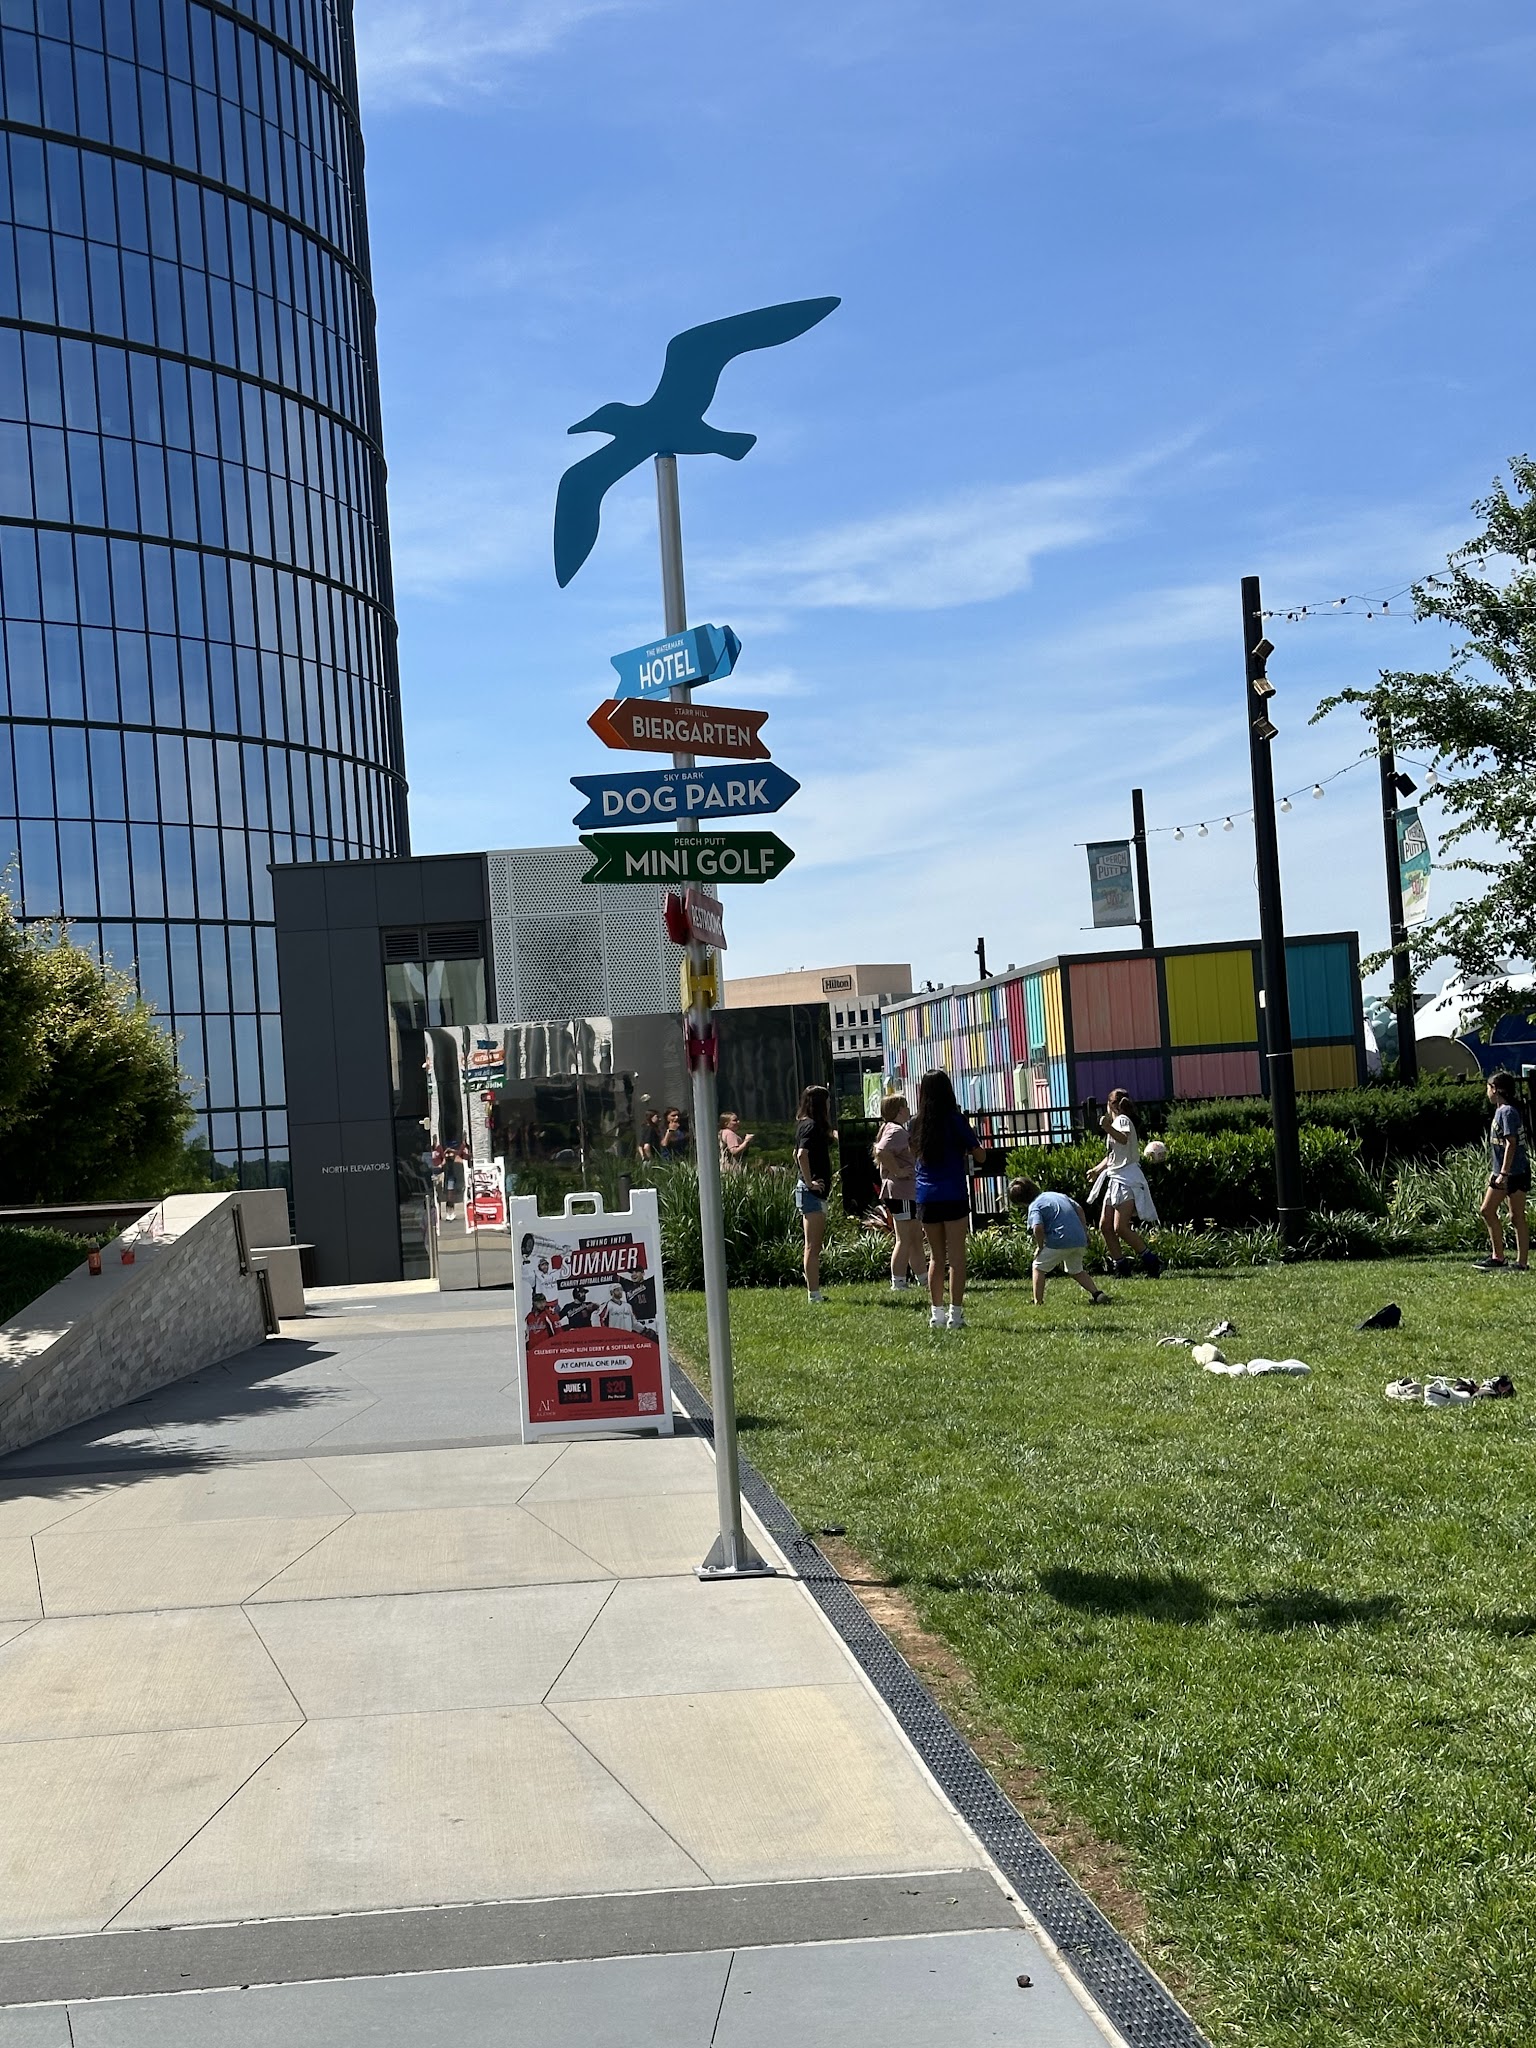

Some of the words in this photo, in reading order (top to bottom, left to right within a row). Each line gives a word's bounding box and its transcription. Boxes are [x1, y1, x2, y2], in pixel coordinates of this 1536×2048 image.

[656, 638, 684, 654] WATERMARK
[640, 649, 696, 690] HOTEL
[674, 708, 693, 716] STARR
[632, 716, 751, 747] BIERGARTEN
[664, 773, 680, 782] SKY
[682, 772, 704, 780] BARK
[602, 785, 677, 816] DOG
[686, 778, 770, 810] PARK
[674, 838, 702, 846] PERCH
[704, 838, 726, 846] PUTT
[1405, 842, 1420, 860] PUTT
[626, 850, 689, 876] MINI
[696, 848, 775, 875] GOLF
[1106, 852, 1127, 864] PERCH
[1098, 866, 1118, 879] PUTT
[825, 980, 849, 990] Hilton
[322, 1166, 348, 1174] NORTH
[350, 1162, 390, 1172] ELEVATORS
[586, 1238, 608, 1248] SWING
[610, 1236, 626, 1244] INTO
[562, 1248, 638, 1279] SUMMER
[560, 1280, 578, 1288] CHARITY
[563, 1383, 581, 1393] JUNE
[582, 1382, 586, 1392] 1
[606, 1381, 626, 1392] $20
